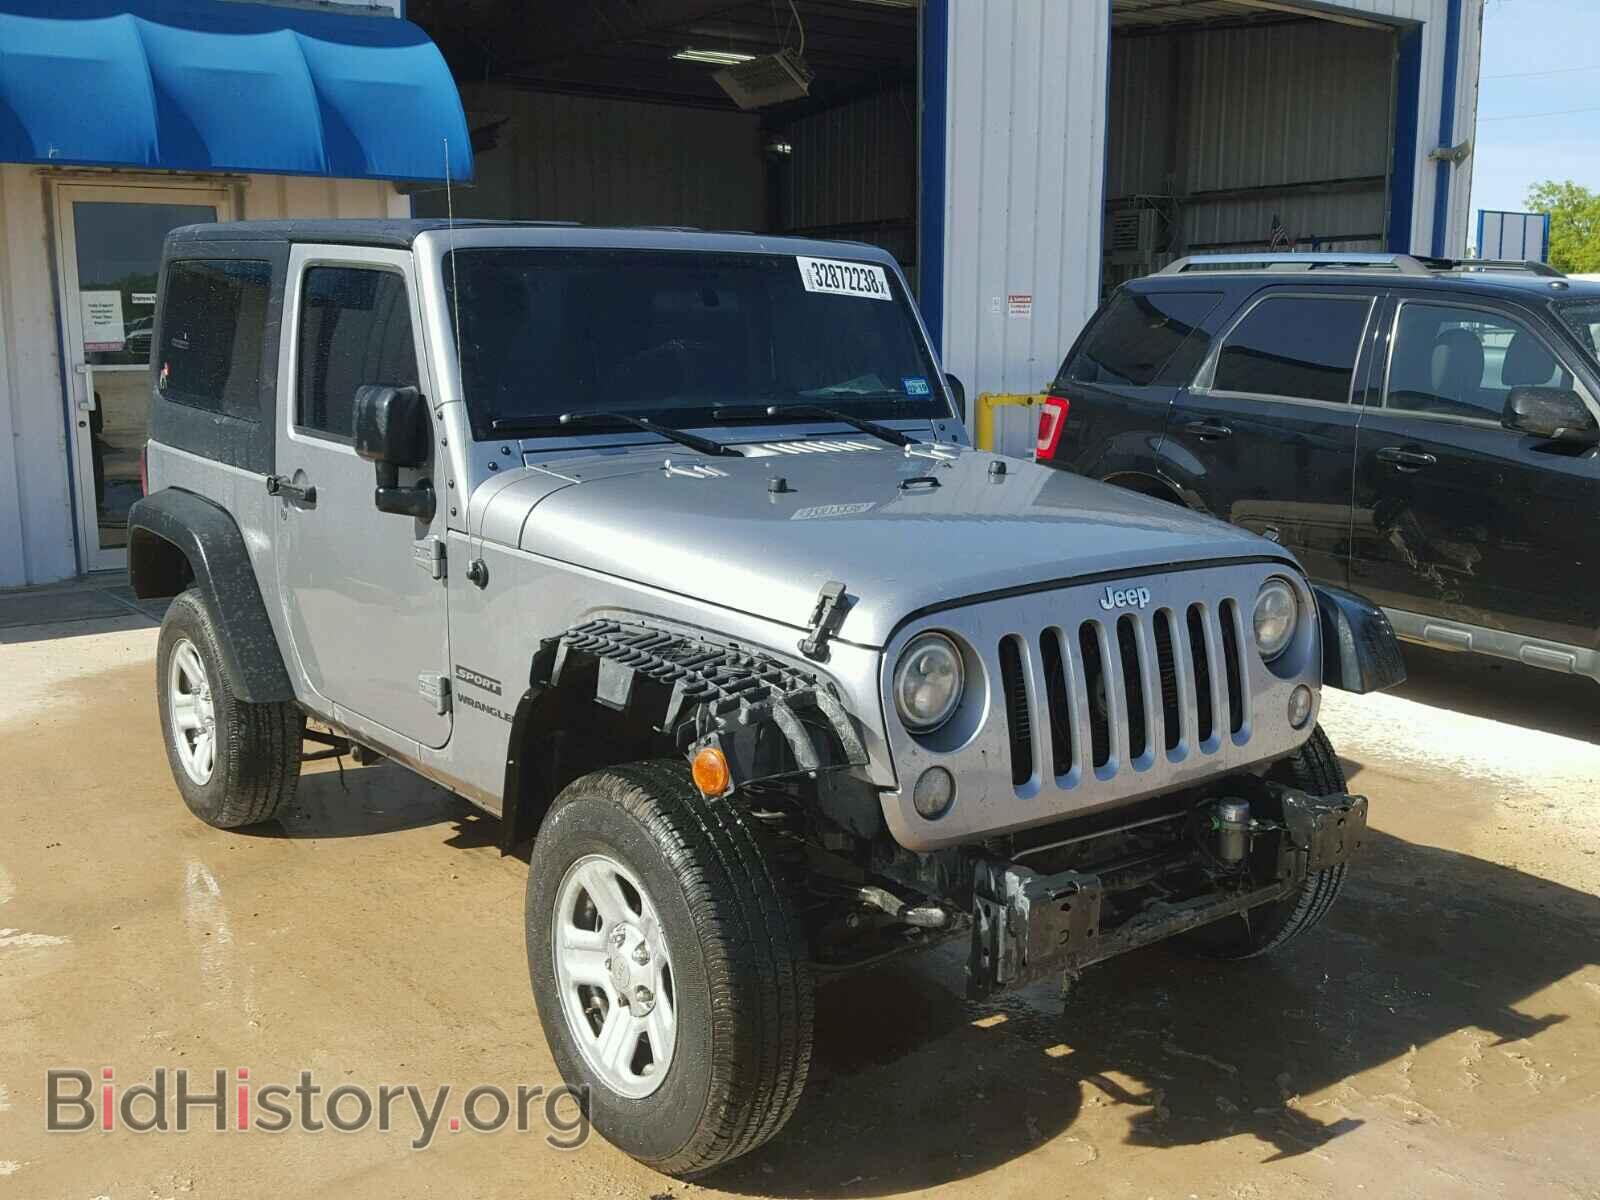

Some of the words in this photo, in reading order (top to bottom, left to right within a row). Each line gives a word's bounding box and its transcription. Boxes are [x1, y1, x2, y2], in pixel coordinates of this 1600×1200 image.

[1100, 586, 1151, 610] Jeep
[458, 669, 503, 692] SPORT
[457, 692, 515, 723] WRANGLE
